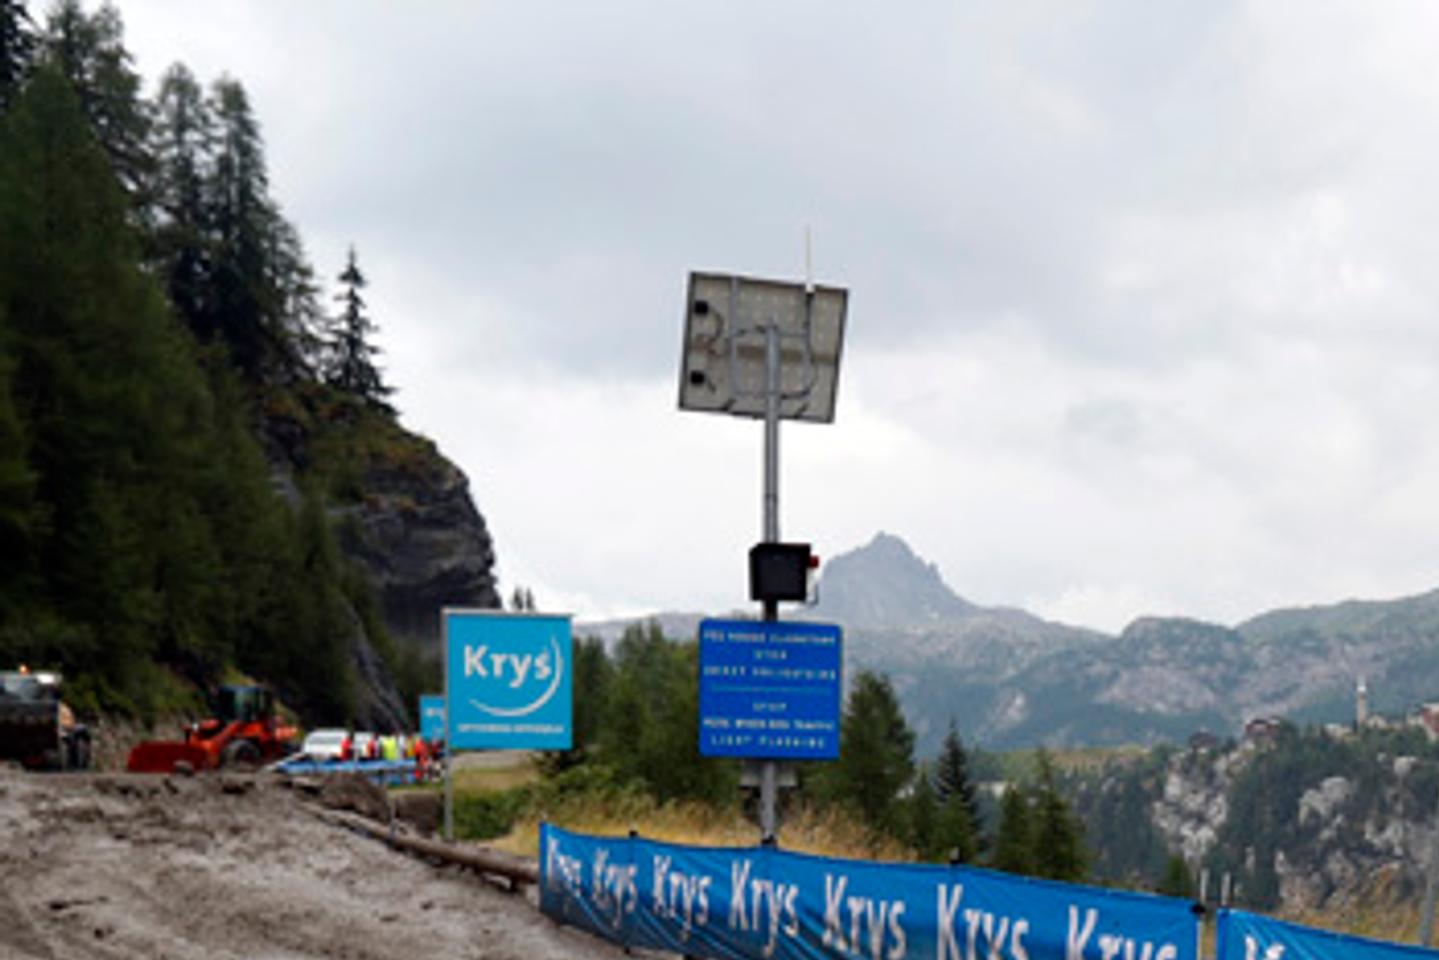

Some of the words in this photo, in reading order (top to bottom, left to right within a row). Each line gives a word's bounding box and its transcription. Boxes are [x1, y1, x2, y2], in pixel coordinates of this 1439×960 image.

[464, 645, 551, 688] Krys
[652, 854, 712, 941] Krys
[730, 858, 799, 956] Krys
